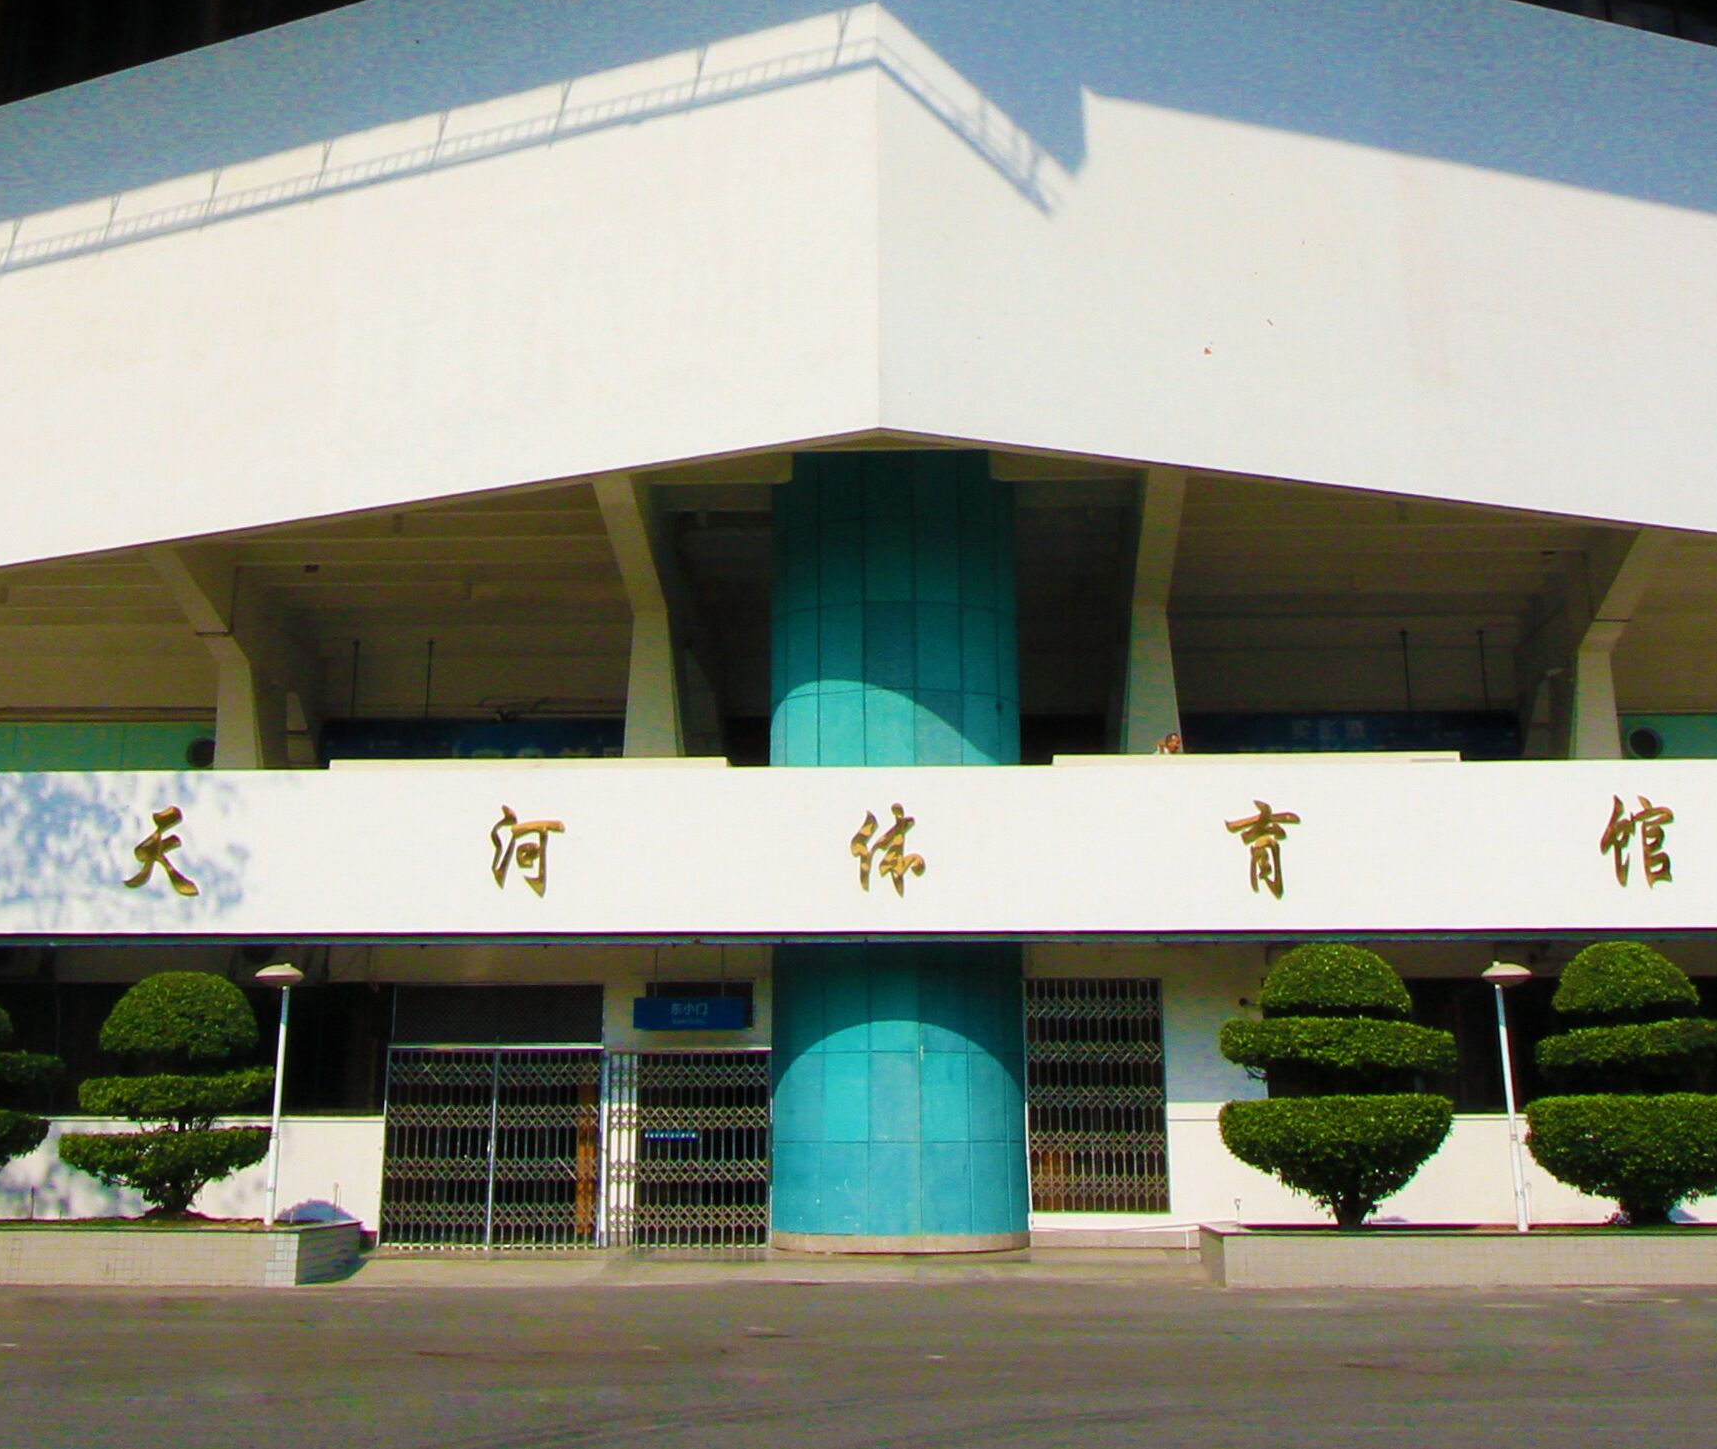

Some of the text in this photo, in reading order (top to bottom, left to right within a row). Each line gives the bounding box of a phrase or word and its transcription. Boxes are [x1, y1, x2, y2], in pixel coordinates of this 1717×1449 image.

[123, 794, 1675, 898] 天河体育馆
